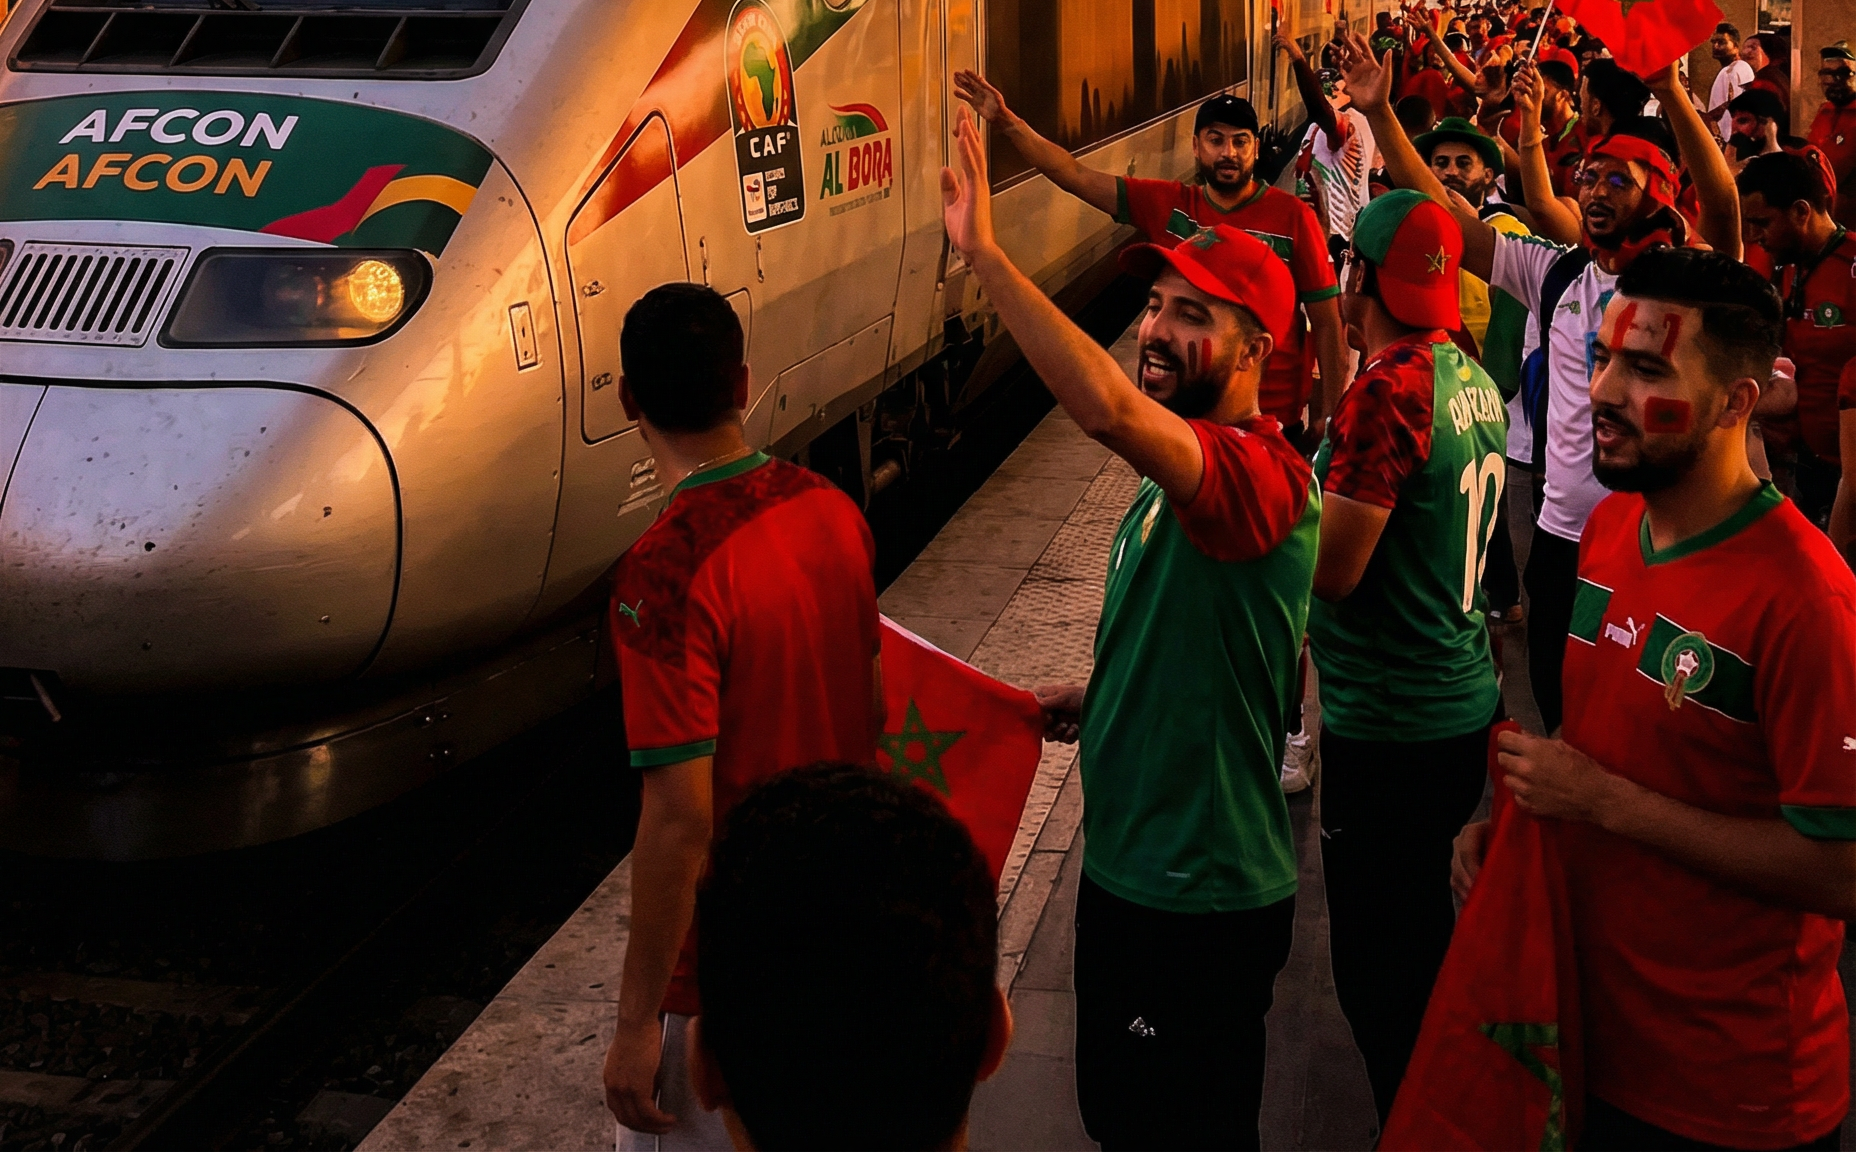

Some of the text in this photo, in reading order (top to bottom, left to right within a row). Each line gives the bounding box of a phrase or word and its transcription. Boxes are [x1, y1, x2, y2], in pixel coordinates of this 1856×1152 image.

[58, 108, 299, 150] AFCON
[749, 131, 787, 158] CAF
[32, 153, 273, 198] AFCON
[819, 150, 844, 201] AL
